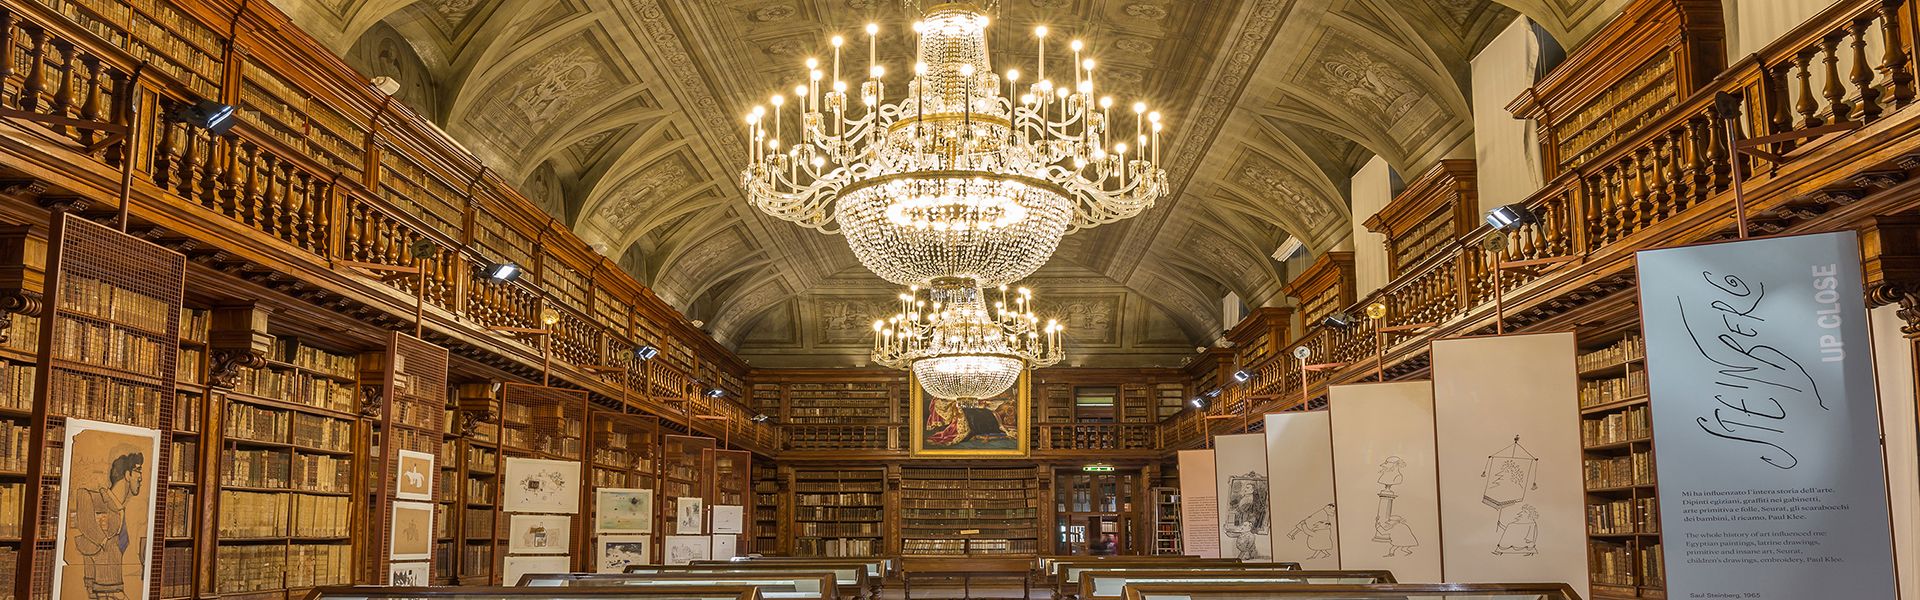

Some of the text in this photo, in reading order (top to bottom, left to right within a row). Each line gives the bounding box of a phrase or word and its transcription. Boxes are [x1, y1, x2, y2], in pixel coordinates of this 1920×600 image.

[1676, 270, 1829, 469] STEINBERG
[1812, 263, 1846, 362] UP CLOSE
